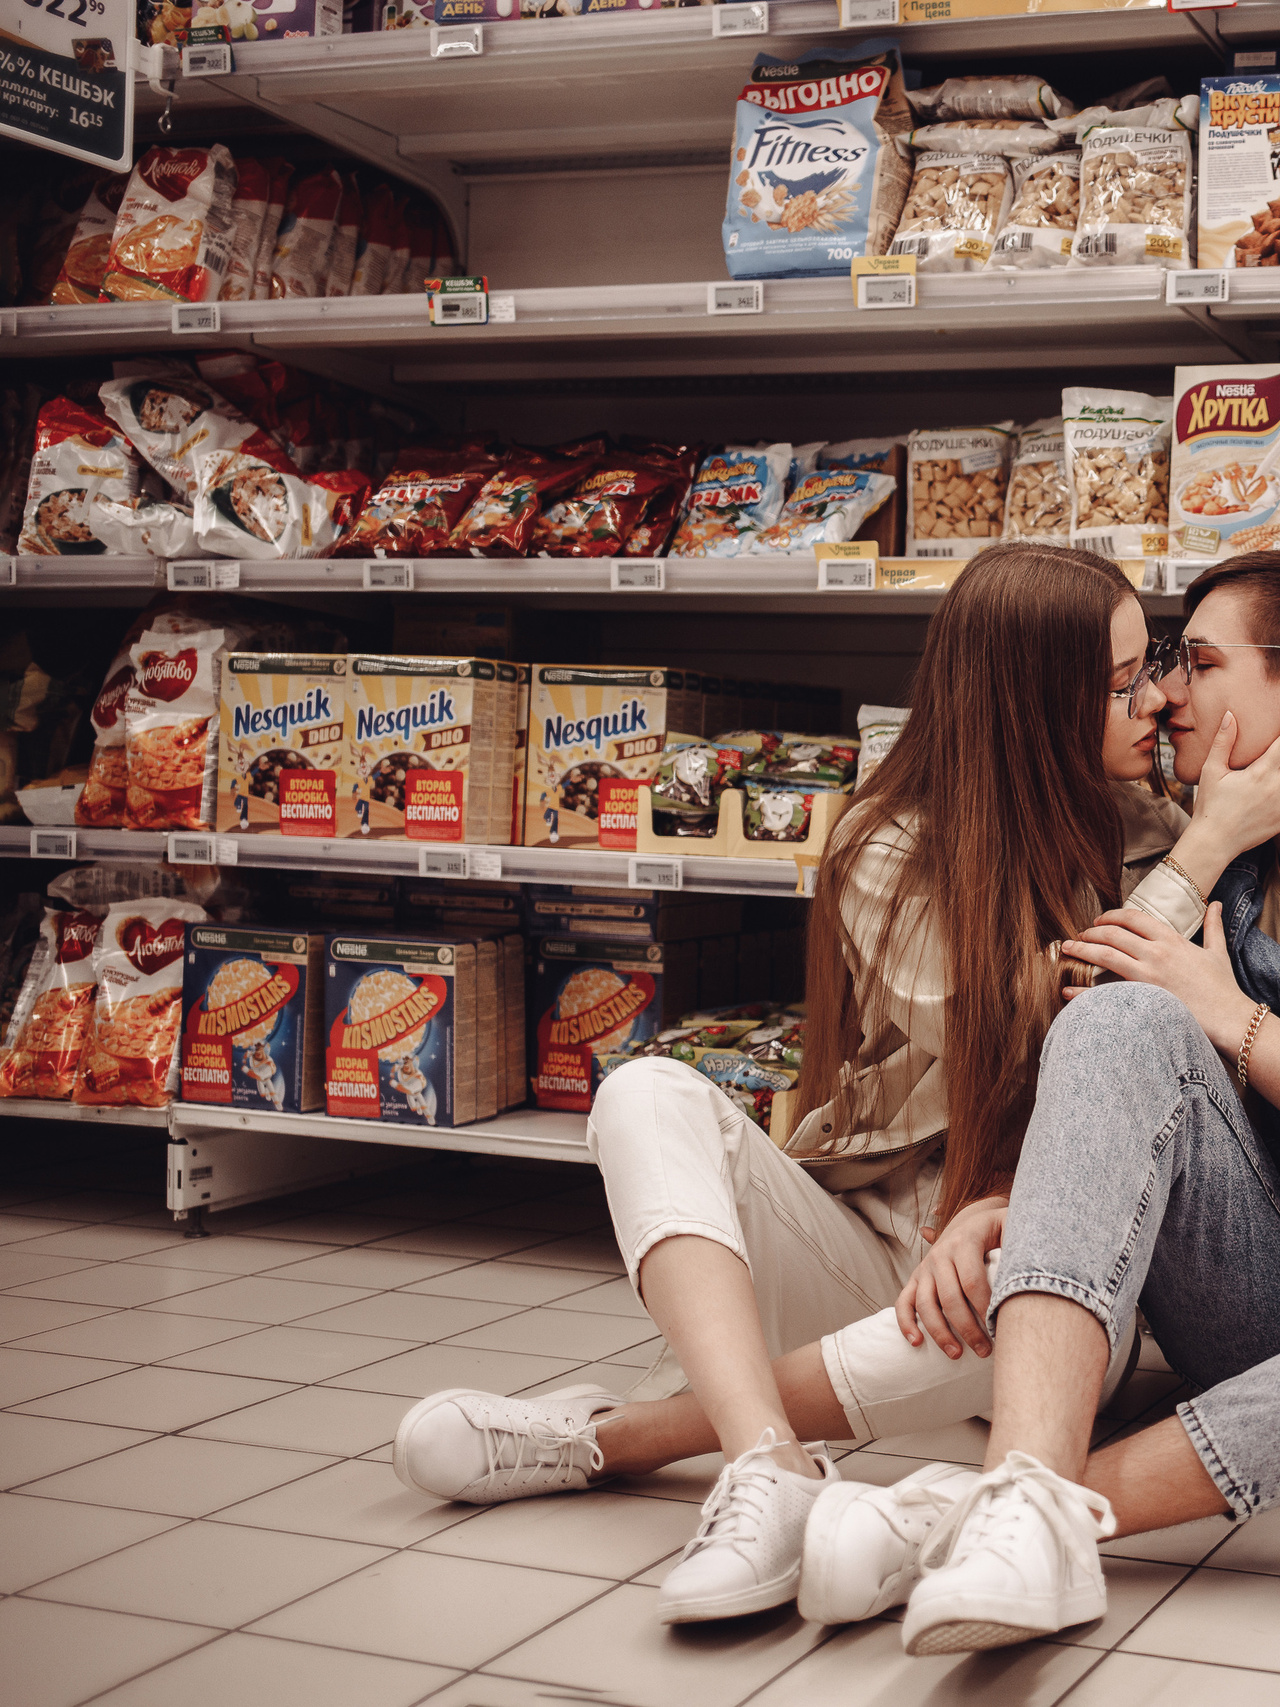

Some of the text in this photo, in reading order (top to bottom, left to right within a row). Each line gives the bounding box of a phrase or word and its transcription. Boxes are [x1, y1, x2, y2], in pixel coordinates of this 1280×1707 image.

[442, 2, 484, 17] ДЕНЬ
[911, 1, 951, 11] Первая
[925, 9, 951, 19] цена
[39, 64, 115, 109] КЕШБЭК
[745, 70, 883, 110] ВЫГОДНО
[22, 98, 59, 118] карту:
[748, 126, 868, 169] Fitness
[1149, 238, 1170, 248] 200
[1187, 385, 1270, 434] ХРУТКА
[911, 437, 994, 451] ПОДУШЕЧКИ
[1145, 537, 1166, 547] 200
[234, 688, 331, 738] Nesquik
[357, 690, 454, 741] Nesquik
[545, 700, 647, 749] Nesquik
[308, 725, 340, 744] DUO
[431, 728, 463, 747] DUO
[624, 738, 657, 755] DUO
[290, 779, 324, 791] ВТОРАЯ
[416, 780, 451, 792] ВТОРАЯ
[285, 791, 329, 804] КОРОБКА
[411, 792, 455, 805] КОРОБКА
[281, 804, 332, 820] БЕСПЛАТНО
[406, 804, 459, 822] БЕСПЛАТНО
[198, 974, 291, 1036] KOSMOSTARS
[342, 985, 439, 1050] KOSMOSTARS
[549, 983, 647, 1045] KOSMOSTARS
[191, 1043, 222, 1055] ВТОРАЯ
[188, 1055, 226, 1068] КОРОБКА
[336, 1056, 368, 1070] ВТОРАЯ
[548, 1052, 581, 1065] ВТОРАЯ
[703, 1058, 746, 1073] Happy
[183, 1067, 230, 1084] БЕСПЛАТНО
[331, 1068, 373, 1083] КОРОБКА
[542, 1064, 586, 1077] КОРОБКА
[328, 1080, 377, 1099] БЕСПЛАТНО
[538, 1075, 588, 1094] БЕСПЛАТНО
